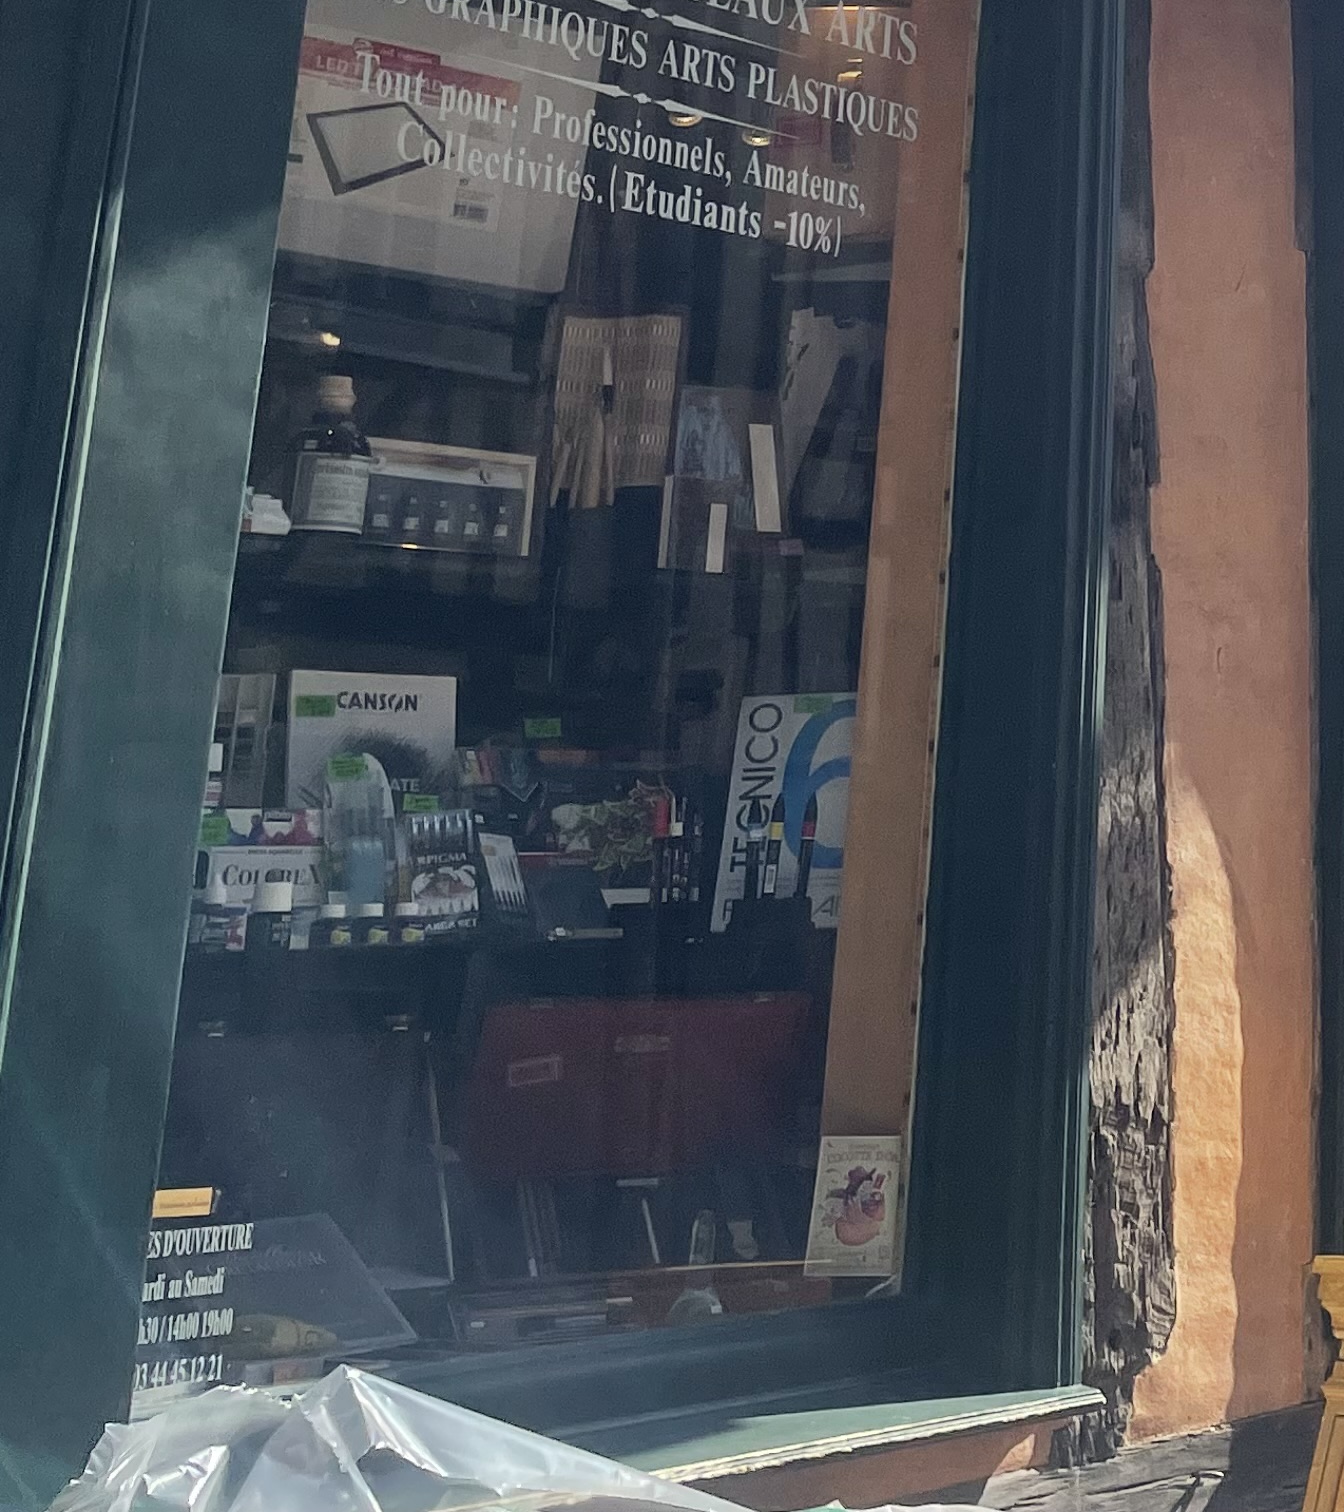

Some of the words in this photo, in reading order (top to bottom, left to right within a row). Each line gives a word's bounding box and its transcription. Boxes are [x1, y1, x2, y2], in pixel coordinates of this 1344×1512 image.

[826, 0, 918, 65] ARTS
[658, 40, 736, 93] ARTS
[747, 61, 919, 142] PLASTIQUES
[356, 51, 424, 105] Tout
[532, 94, 732, 187] Professionnels,
[743, 150, 865, 216] Amateurs,
[773, 210, 842, 258] -10%)
[336, 691, 419, 713] CANSON
[163, 1223, 253, 1257] D'OUVERTURE
[168, 1279, 182, 1299] au
[184, 1266, 225, 1297] Samedi
[167, 1312, 199, 1343] 14h00
[201, 1308, 234, 1338] 19h00
[191, 1356, 205, 1383] 12
[208, 1354, 223, 1380] 21
